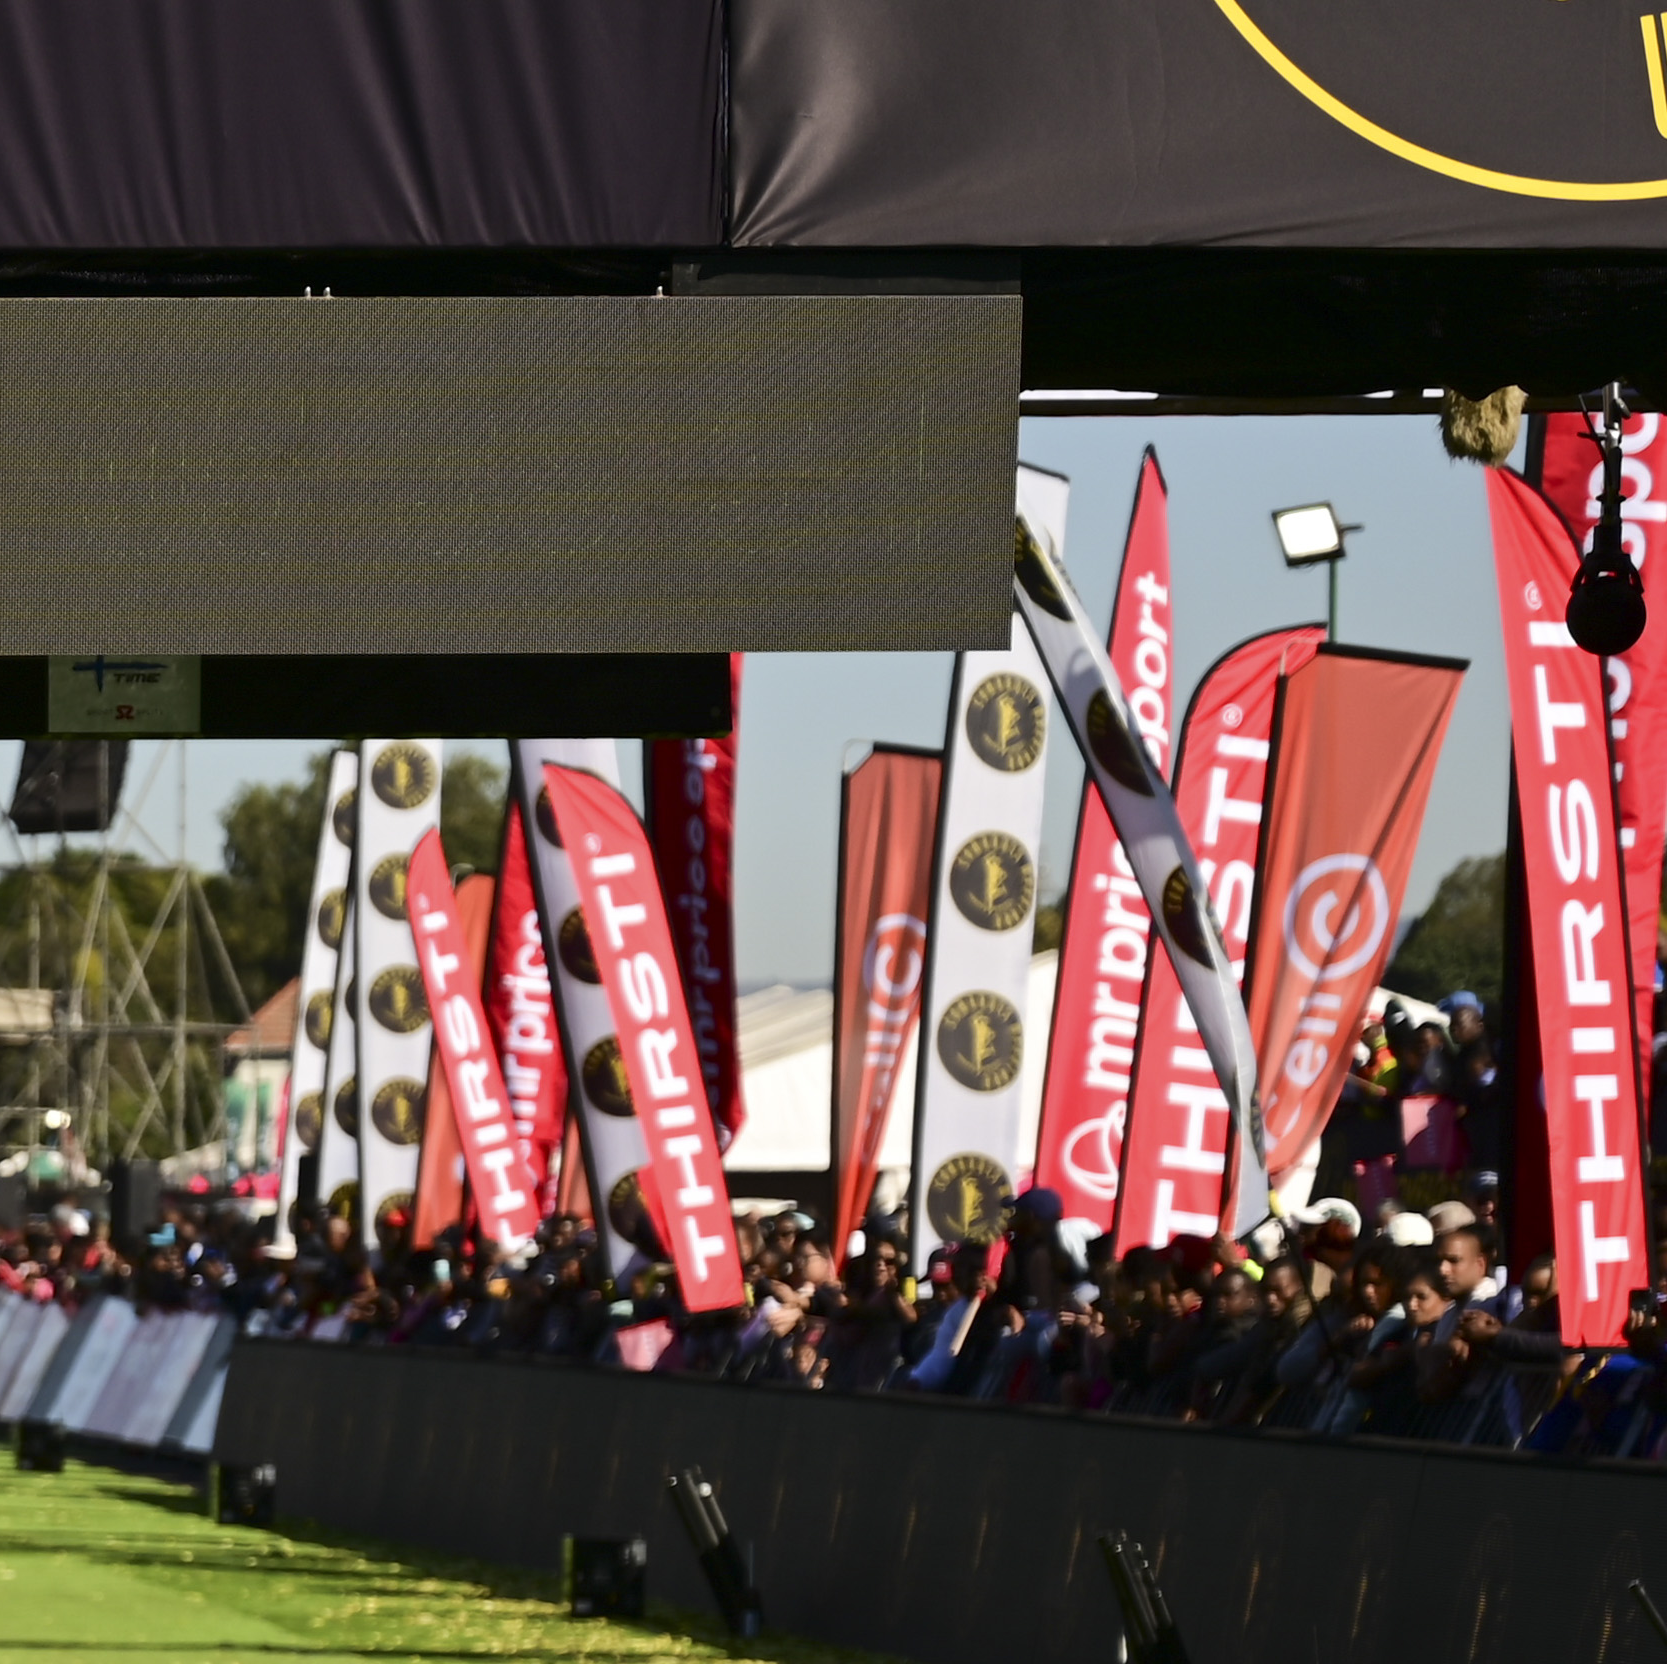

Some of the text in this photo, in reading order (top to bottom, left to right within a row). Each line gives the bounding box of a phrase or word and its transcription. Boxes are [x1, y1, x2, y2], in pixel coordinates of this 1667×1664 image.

[589, 853, 727, 1283] THIRSTI
[1084, 982, 1143, 1092] mr
[1152, 733, 1270, 1250] THISTI
[1528, 621, 1630, 1302] THIRSTI
